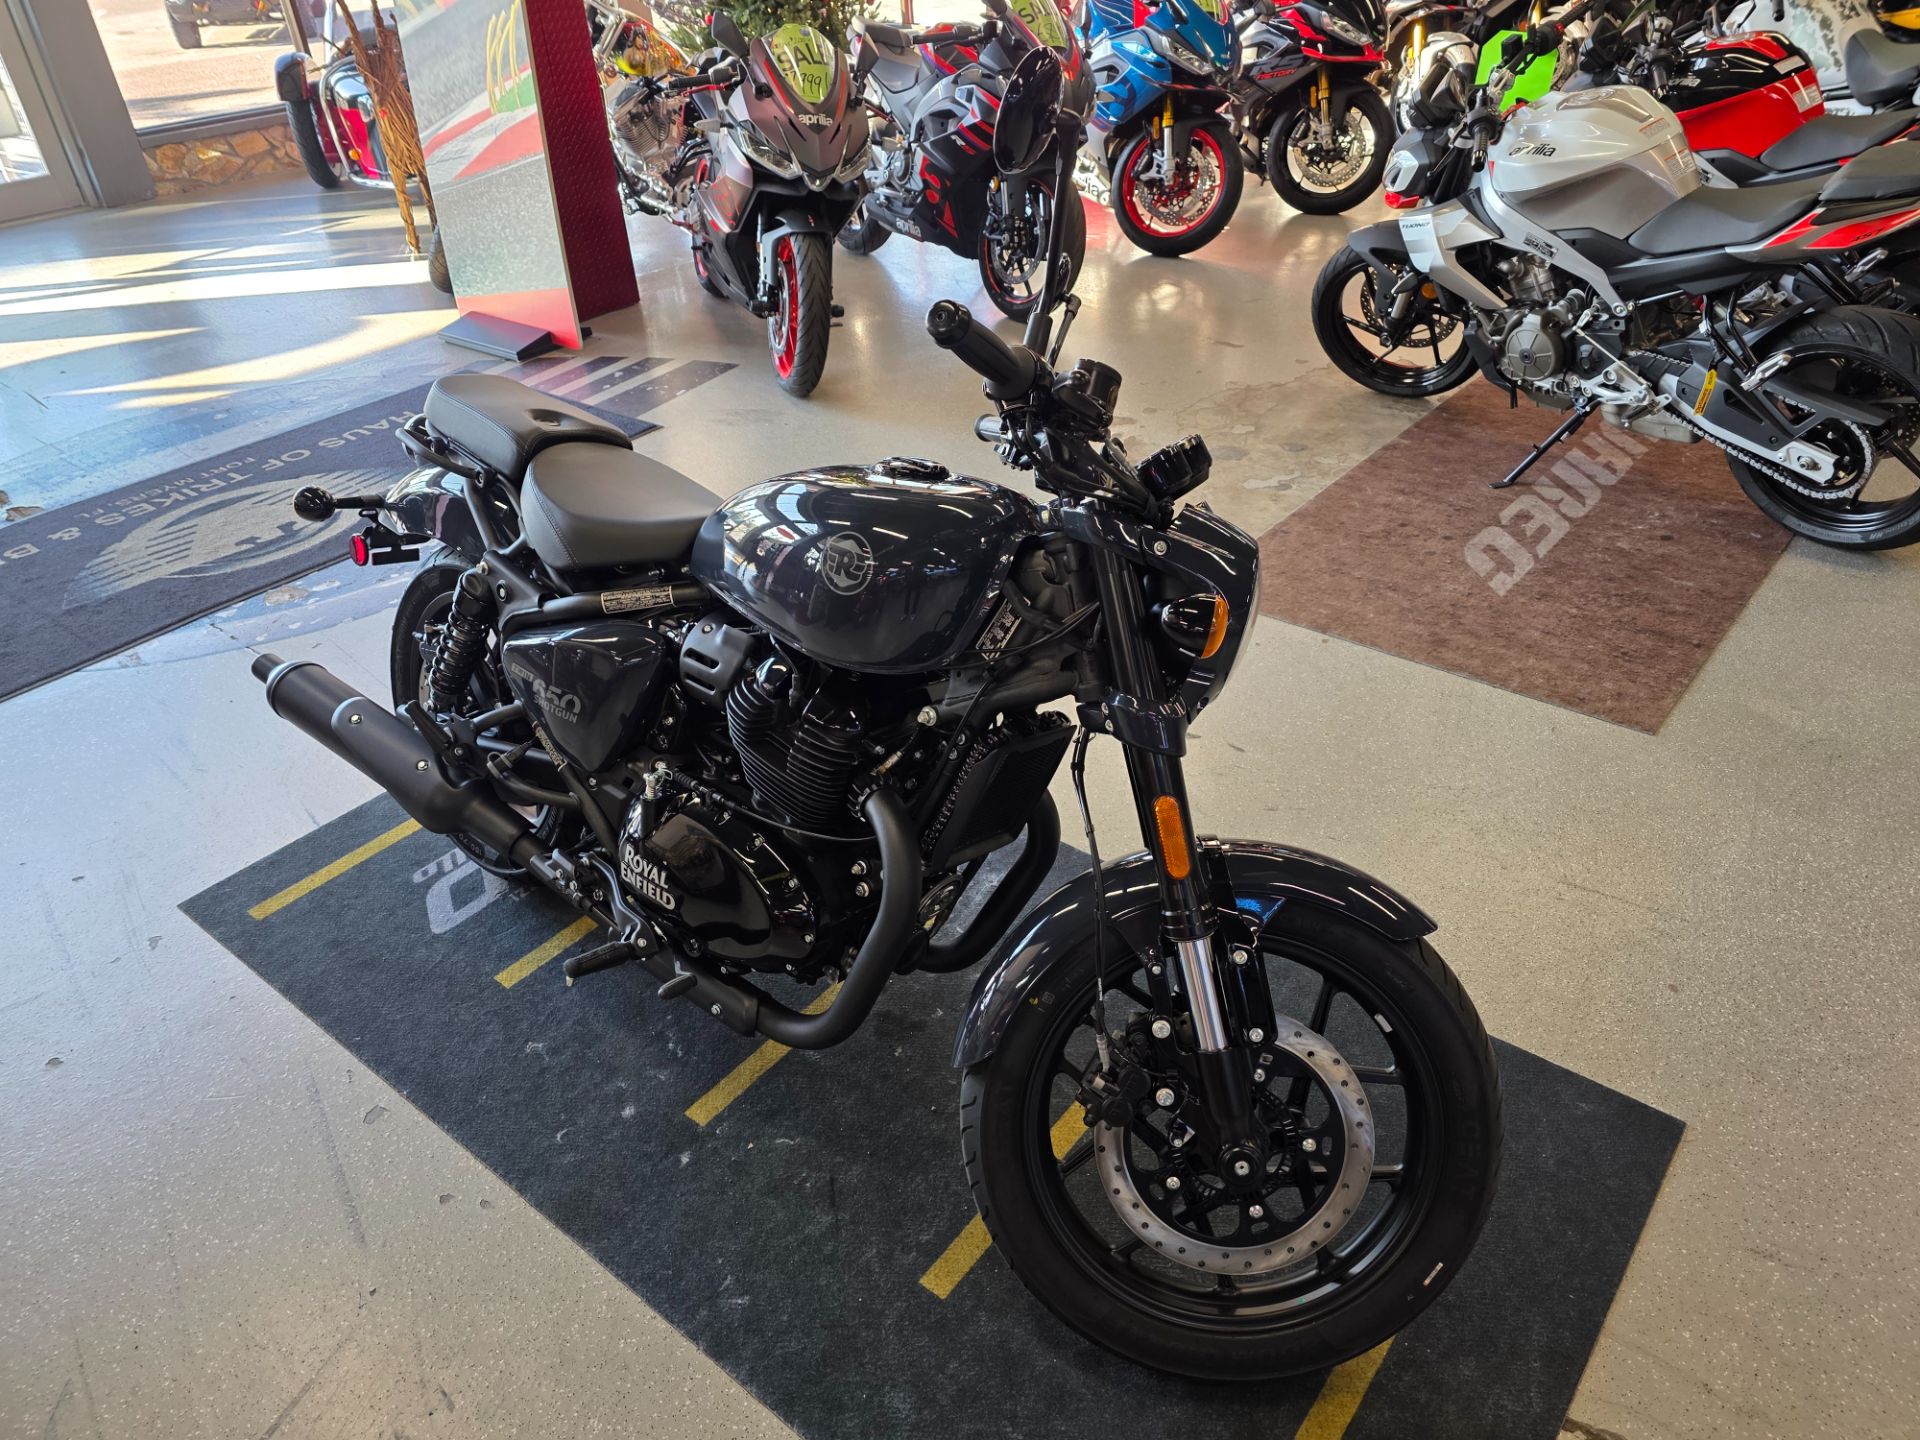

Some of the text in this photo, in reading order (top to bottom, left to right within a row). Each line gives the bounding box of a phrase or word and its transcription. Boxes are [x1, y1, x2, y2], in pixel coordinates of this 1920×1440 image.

[798, 112, 834, 127] aprilia
[895, 216, 922, 238] aprilia
[318, 410, 418, 449] HAUS
[201, 456, 256, 479] FORT
[261, 449, 312, 472] OF
[95, 472, 254, 527] TRIKES
[46, 526, 82, 541] &
[532, 678, 582, 716] 650
[533, 694, 579, 724] SHOTGUN
[624, 842, 669, 890] ROYAL
[620, 860, 676, 911] ENFIELD
